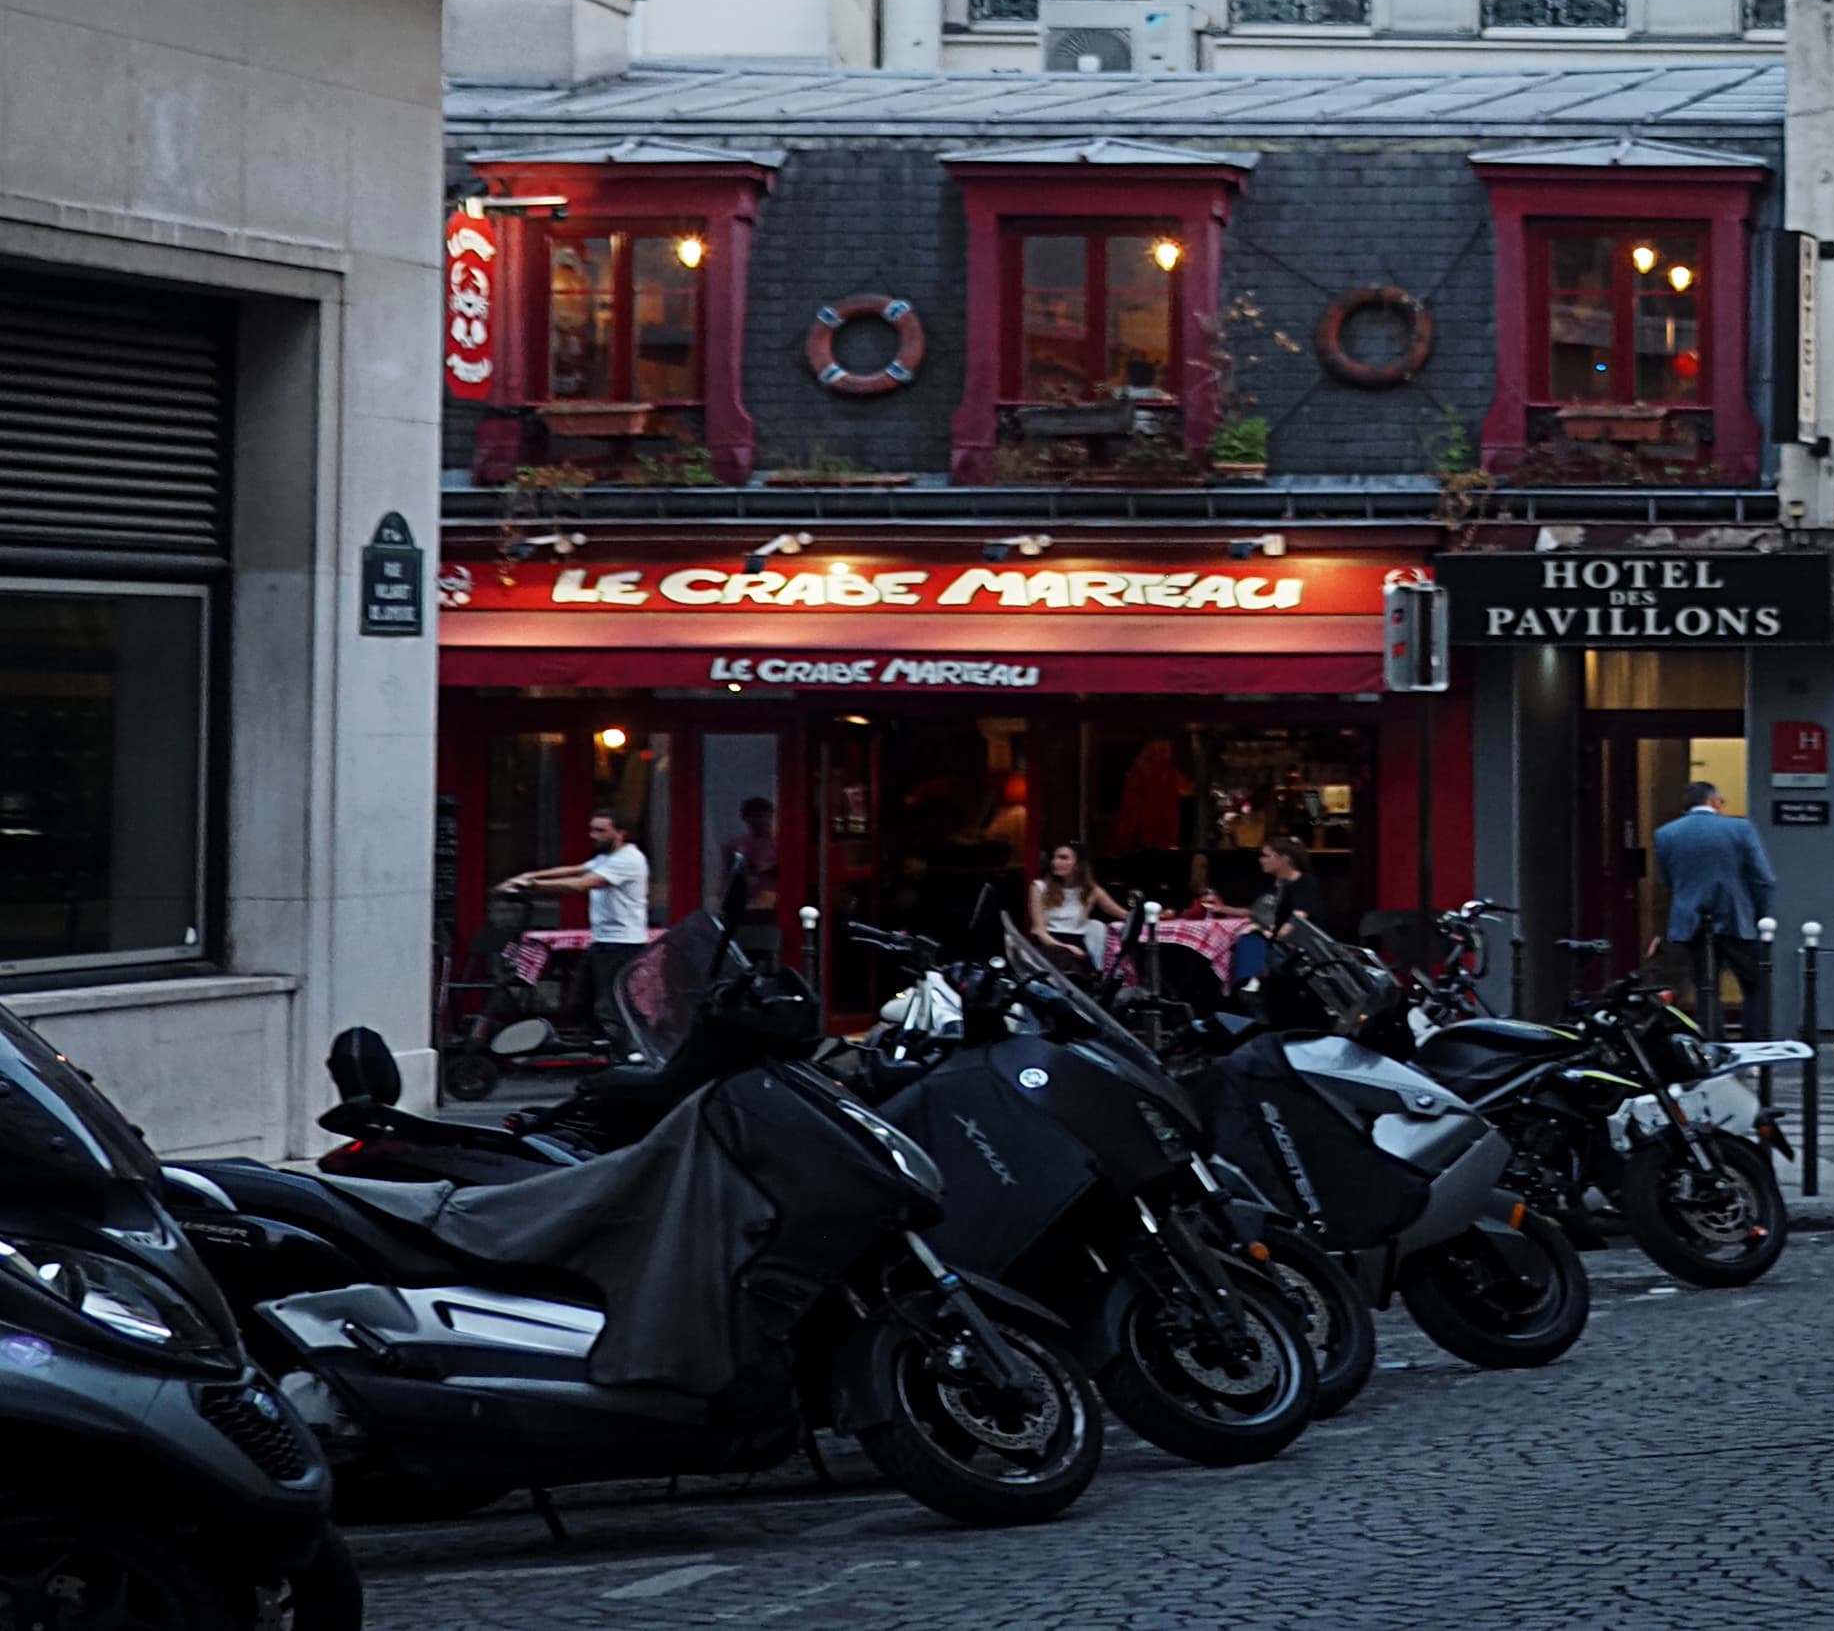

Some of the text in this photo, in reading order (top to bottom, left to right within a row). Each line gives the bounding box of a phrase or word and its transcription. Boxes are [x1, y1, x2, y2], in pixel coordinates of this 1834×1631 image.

[551, 568, 1304, 610] LE CRABE MARTEAU
[1542, 561, 1724, 589] HOTEL
[1608, 590, 1657, 606] DES
[1485, 607, 1782, 636] PAVILLONS
[709, 656, 1040, 687] LE CRABE MARTEAU
